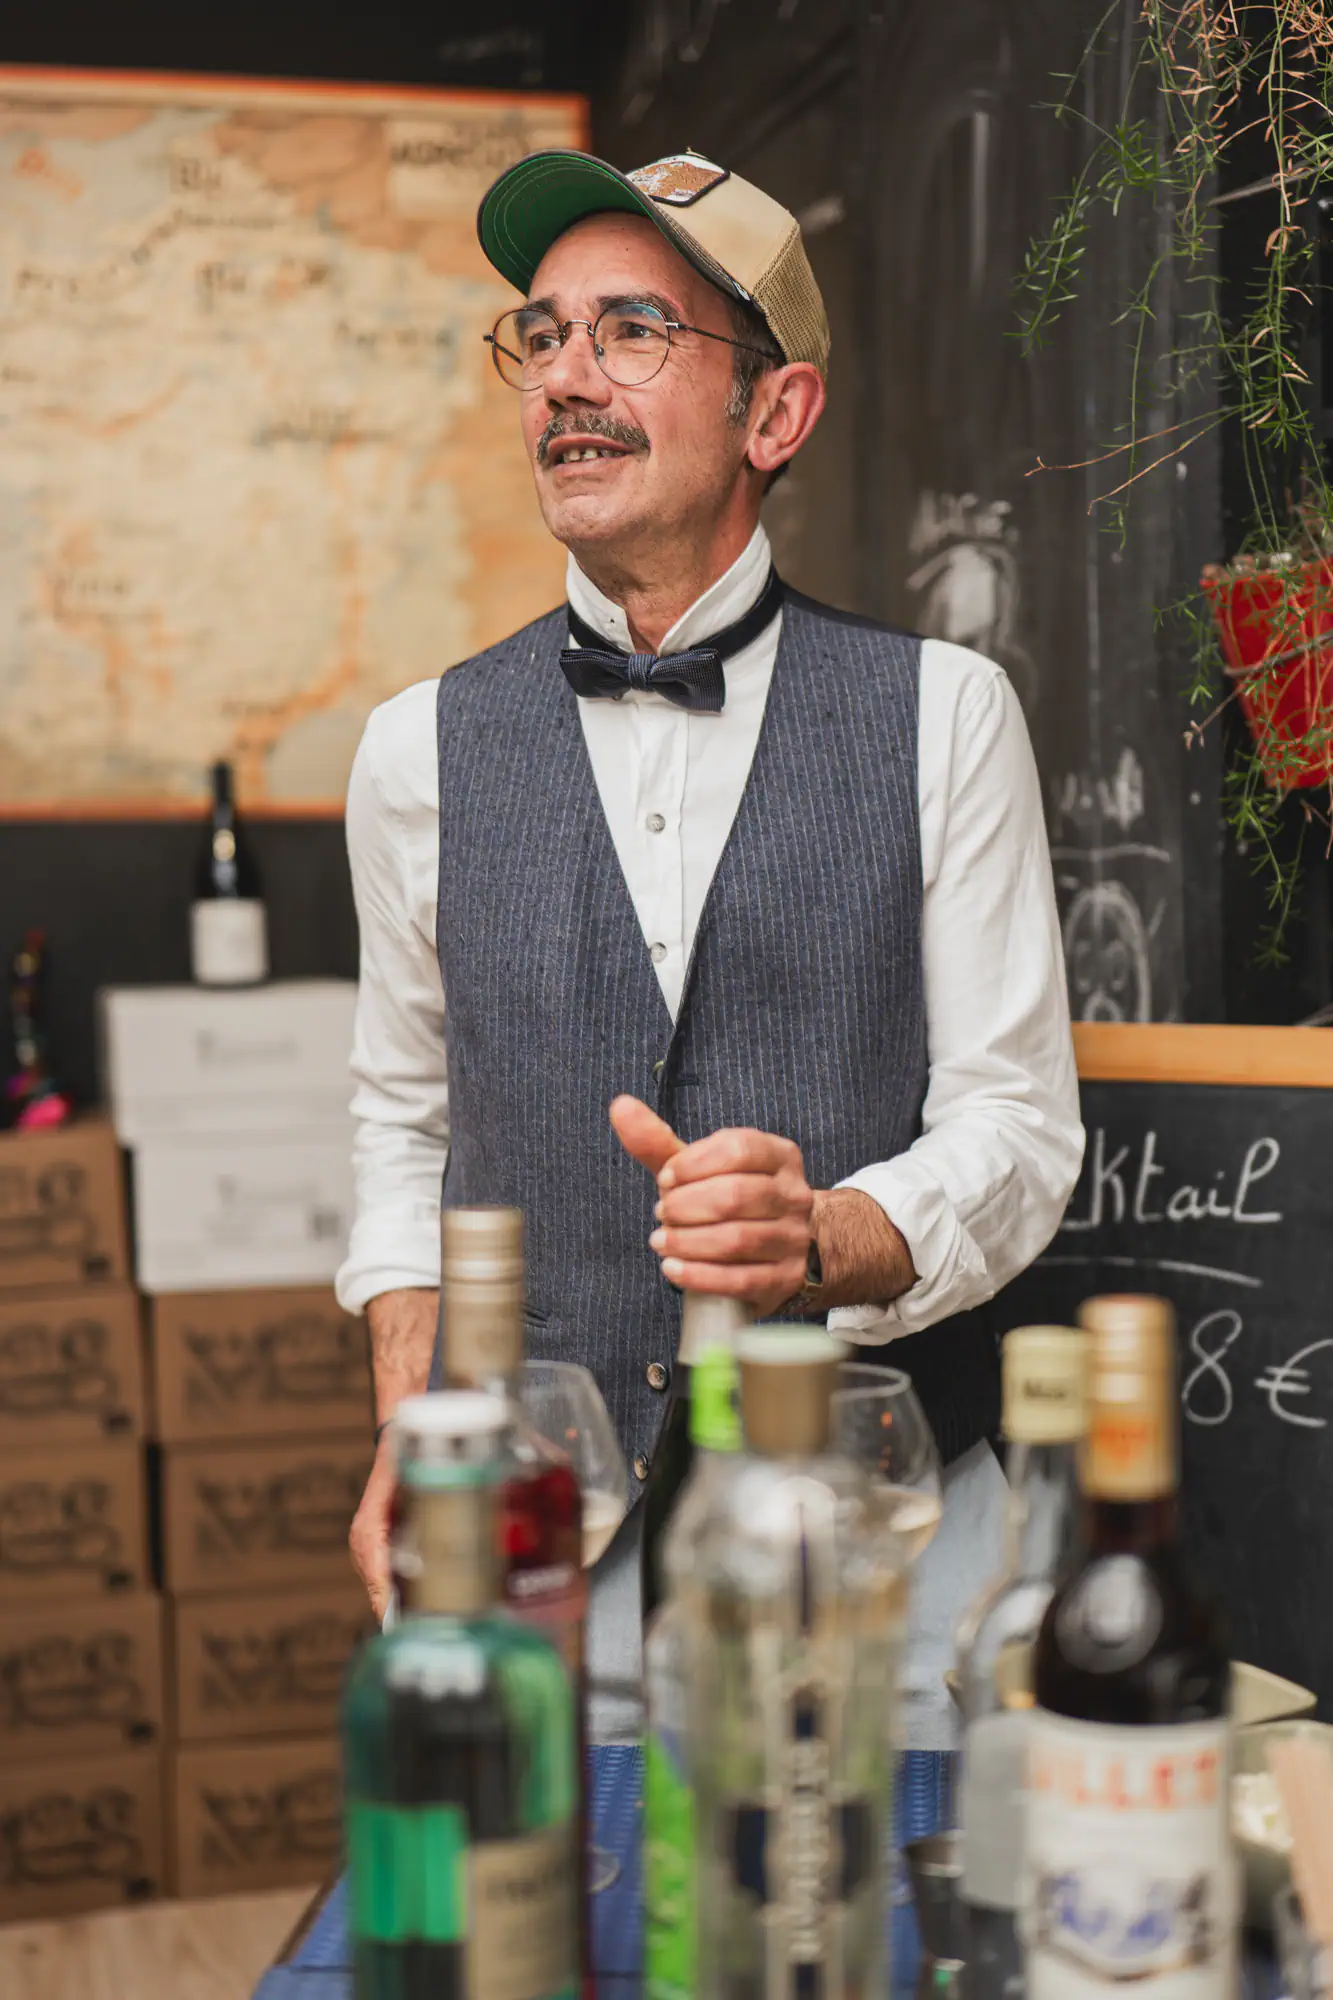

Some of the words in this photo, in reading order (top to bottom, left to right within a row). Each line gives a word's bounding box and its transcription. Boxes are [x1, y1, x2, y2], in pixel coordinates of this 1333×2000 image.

[1060, 1128, 1283, 1230] ktail
[1181, 1309, 1243, 1426] 8
[1255, 1338, 1333, 1428] €
